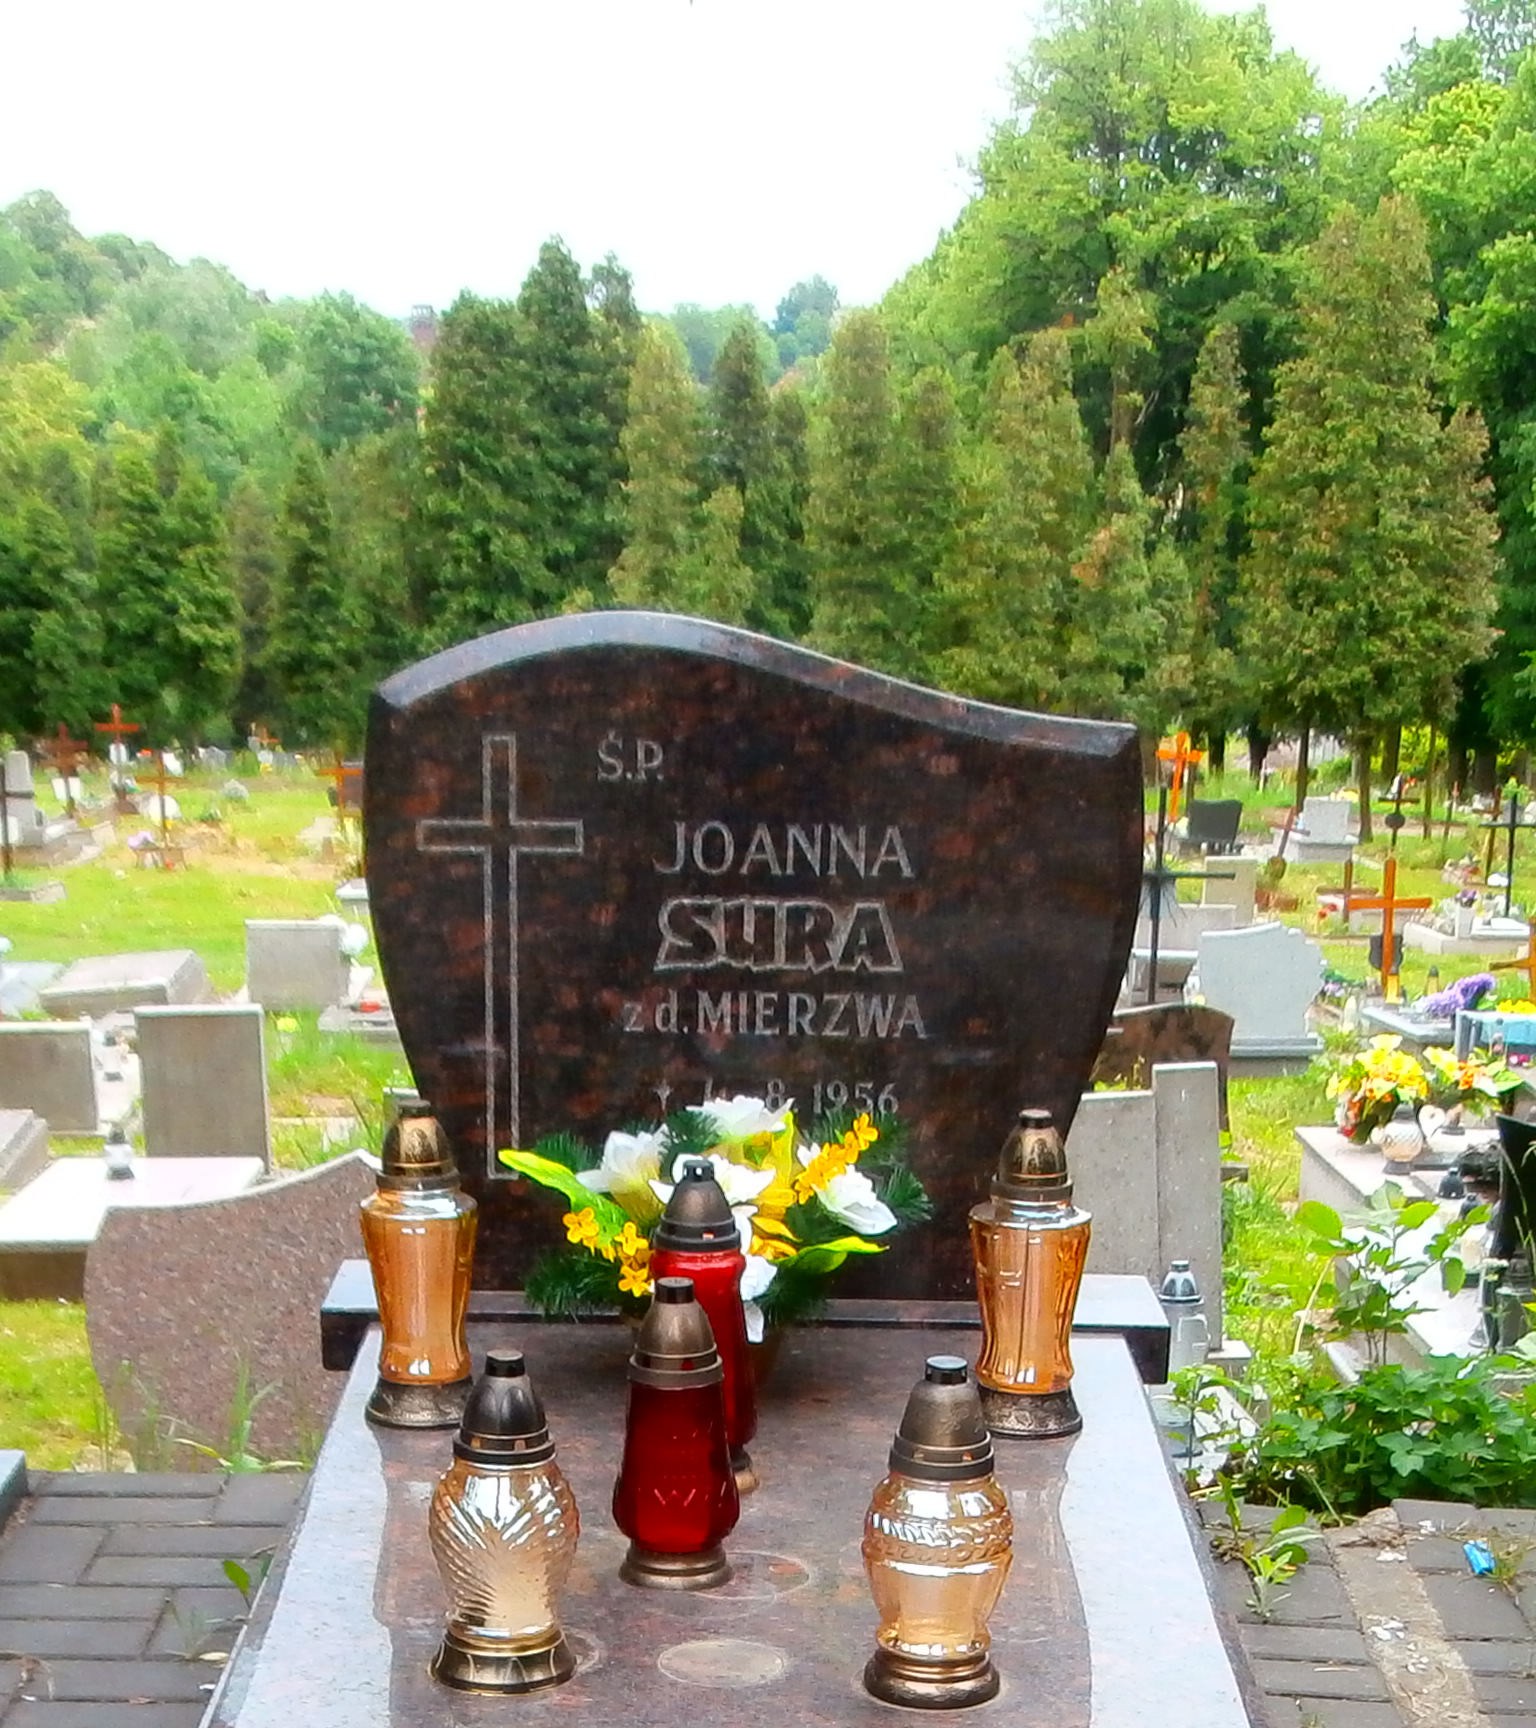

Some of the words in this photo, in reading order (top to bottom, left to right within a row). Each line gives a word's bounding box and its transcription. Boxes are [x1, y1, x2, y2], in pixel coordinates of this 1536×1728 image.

[597, 731, 664, 781] Ś.P.
[653, 819, 915, 879] JOANNA
[654, 896, 905, 974] SURA
[695, 987, 928, 1039] MIERZWA
